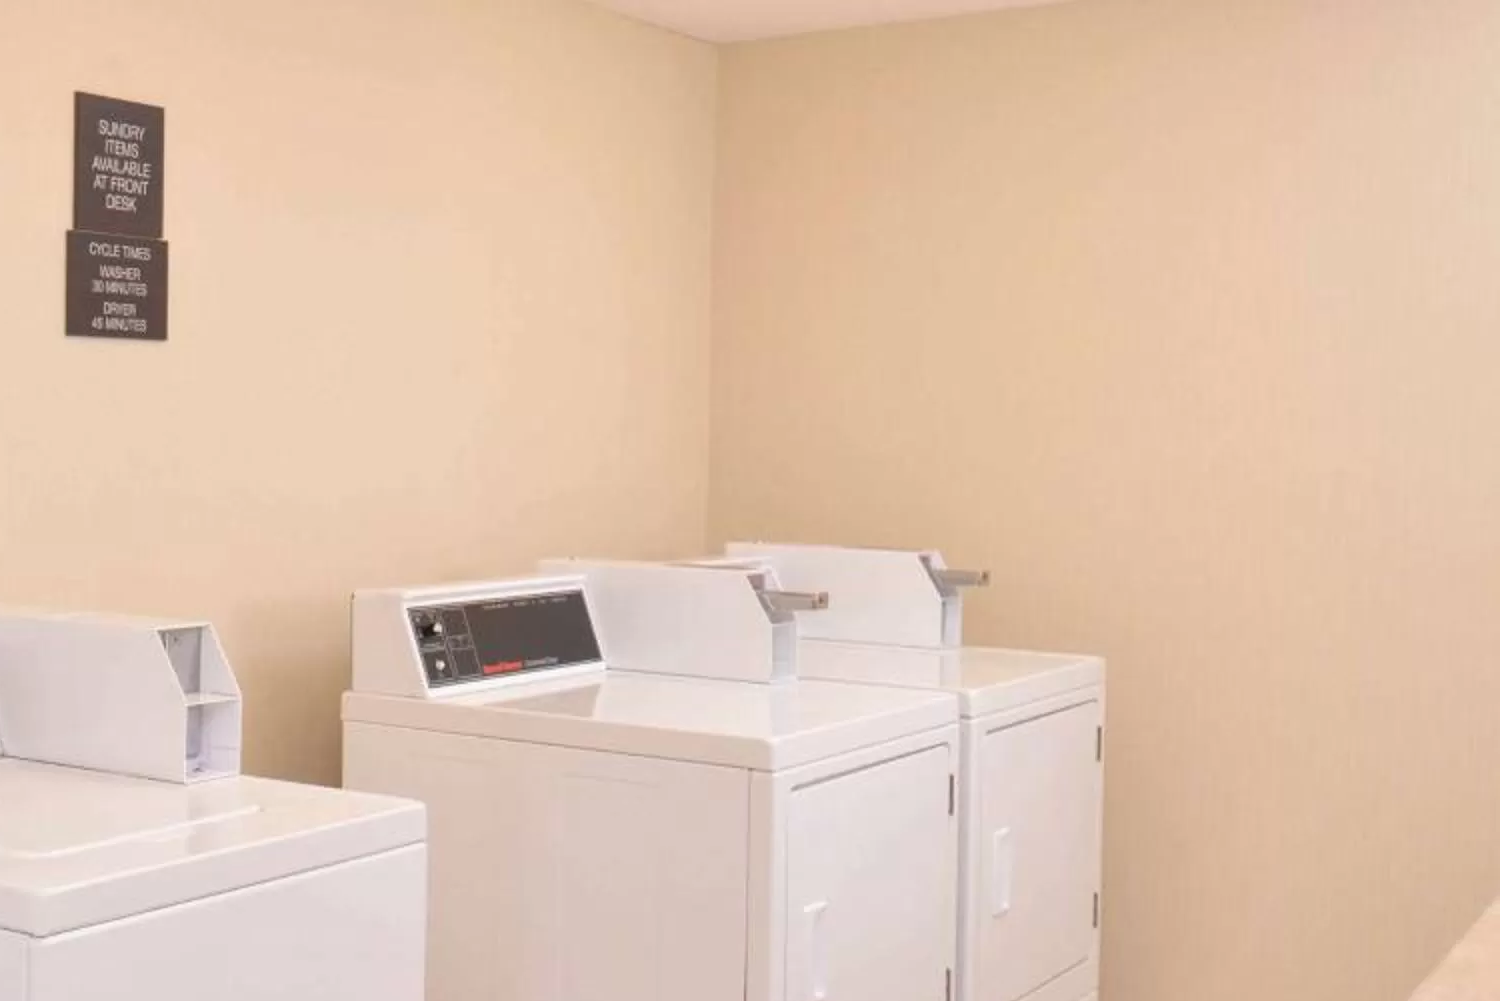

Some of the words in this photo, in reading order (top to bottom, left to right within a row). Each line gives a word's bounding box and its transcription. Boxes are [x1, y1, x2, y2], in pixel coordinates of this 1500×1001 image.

[99, 119, 145, 141] SUNDRY
[104, 139, 140, 158] ITEMS
[92, 156, 152, 178] AVAILABLE
[94, 174, 108, 189] AT
[111, 176, 149, 196] FRONT
[105, 193, 137, 213] DESK
[89, 242, 120, 257] CYCLE
[122, 245, 152, 261] TIMES
[100, 264, 141, 280] WASHER
[106, 281, 147, 297] MINUTES
[104, 302, 137, 317] DRYER
[106, 317, 147, 332] MINUTES
